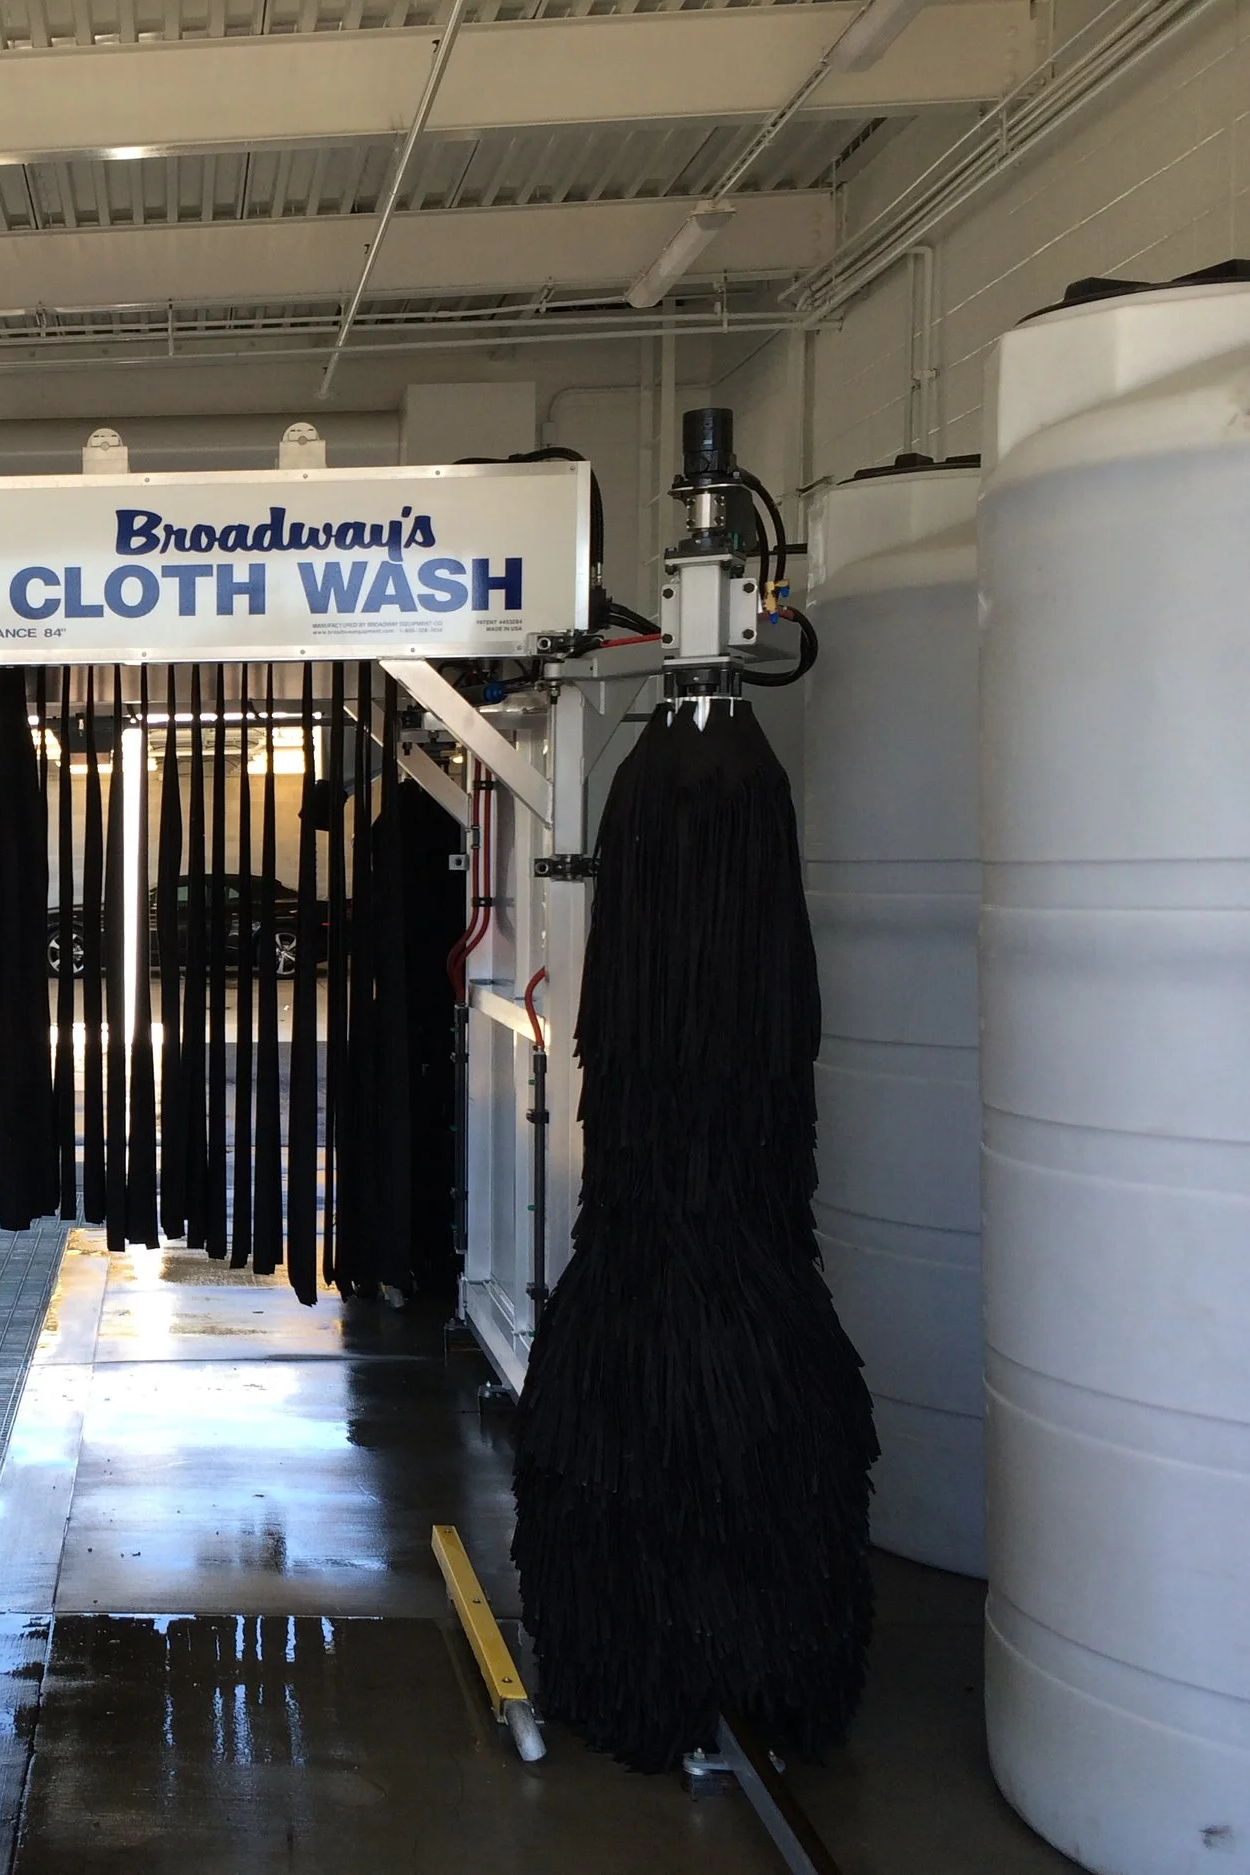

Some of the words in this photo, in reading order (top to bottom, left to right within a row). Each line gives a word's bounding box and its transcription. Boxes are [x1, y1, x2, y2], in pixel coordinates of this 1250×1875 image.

[115, 506, 435, 562] Broadway's
[8, 563, 267, 620] CLOTH
[297, 556, 524, 615] WASH
[44, 628, 66, 638] 84"
